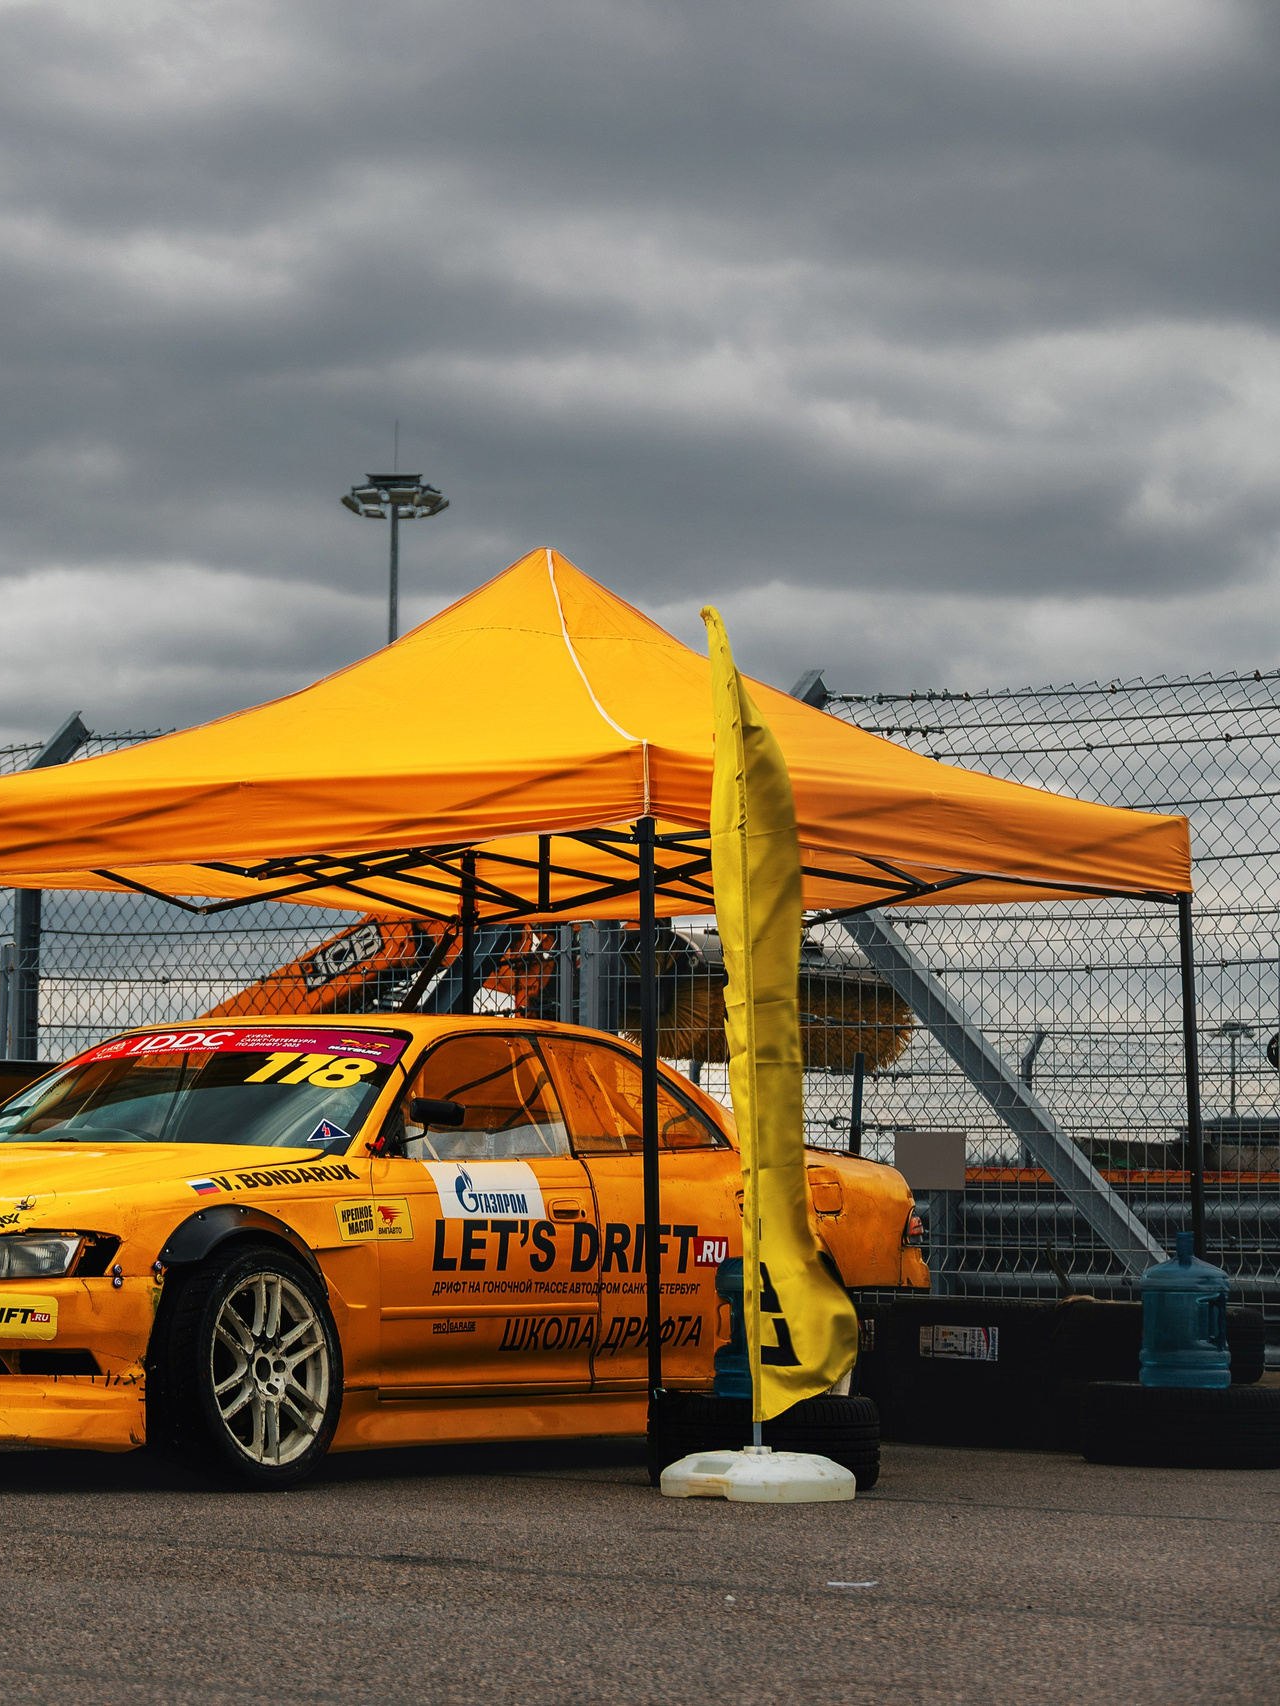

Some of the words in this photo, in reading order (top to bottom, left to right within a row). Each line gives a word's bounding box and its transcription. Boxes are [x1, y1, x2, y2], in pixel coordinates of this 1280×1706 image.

[306, 924, 382, 988] JCB
[130, 1031, 235, 1052] IDDC
[244, 1052, 377, 1088] 118
[210, 1177, 241, 1191] V.
[235, 1164, 360, 1188] BONDARUK
[341, 1205, 373, 1223] КРЕПКОЕ
[478, 1193, 528, 1214] ГАЗПРОМ
[348, 1218, 374, 1235] МАСЛО
[432, 1281, 467, 1296] ДРИФТ
[468, 1281, 481, 1293] НА
[482, 1279, 532, 1294] ГОНОЧНОЙ
[534, 1281, 568, 1294] ТРАССЕ
[568, 1282, 620, 1296] АВТОДРОМ
[622, 1282, 701, 1295] САНКЕТЕРБУРГ
[498, 1317, 594, 1351] ШКОЛА
